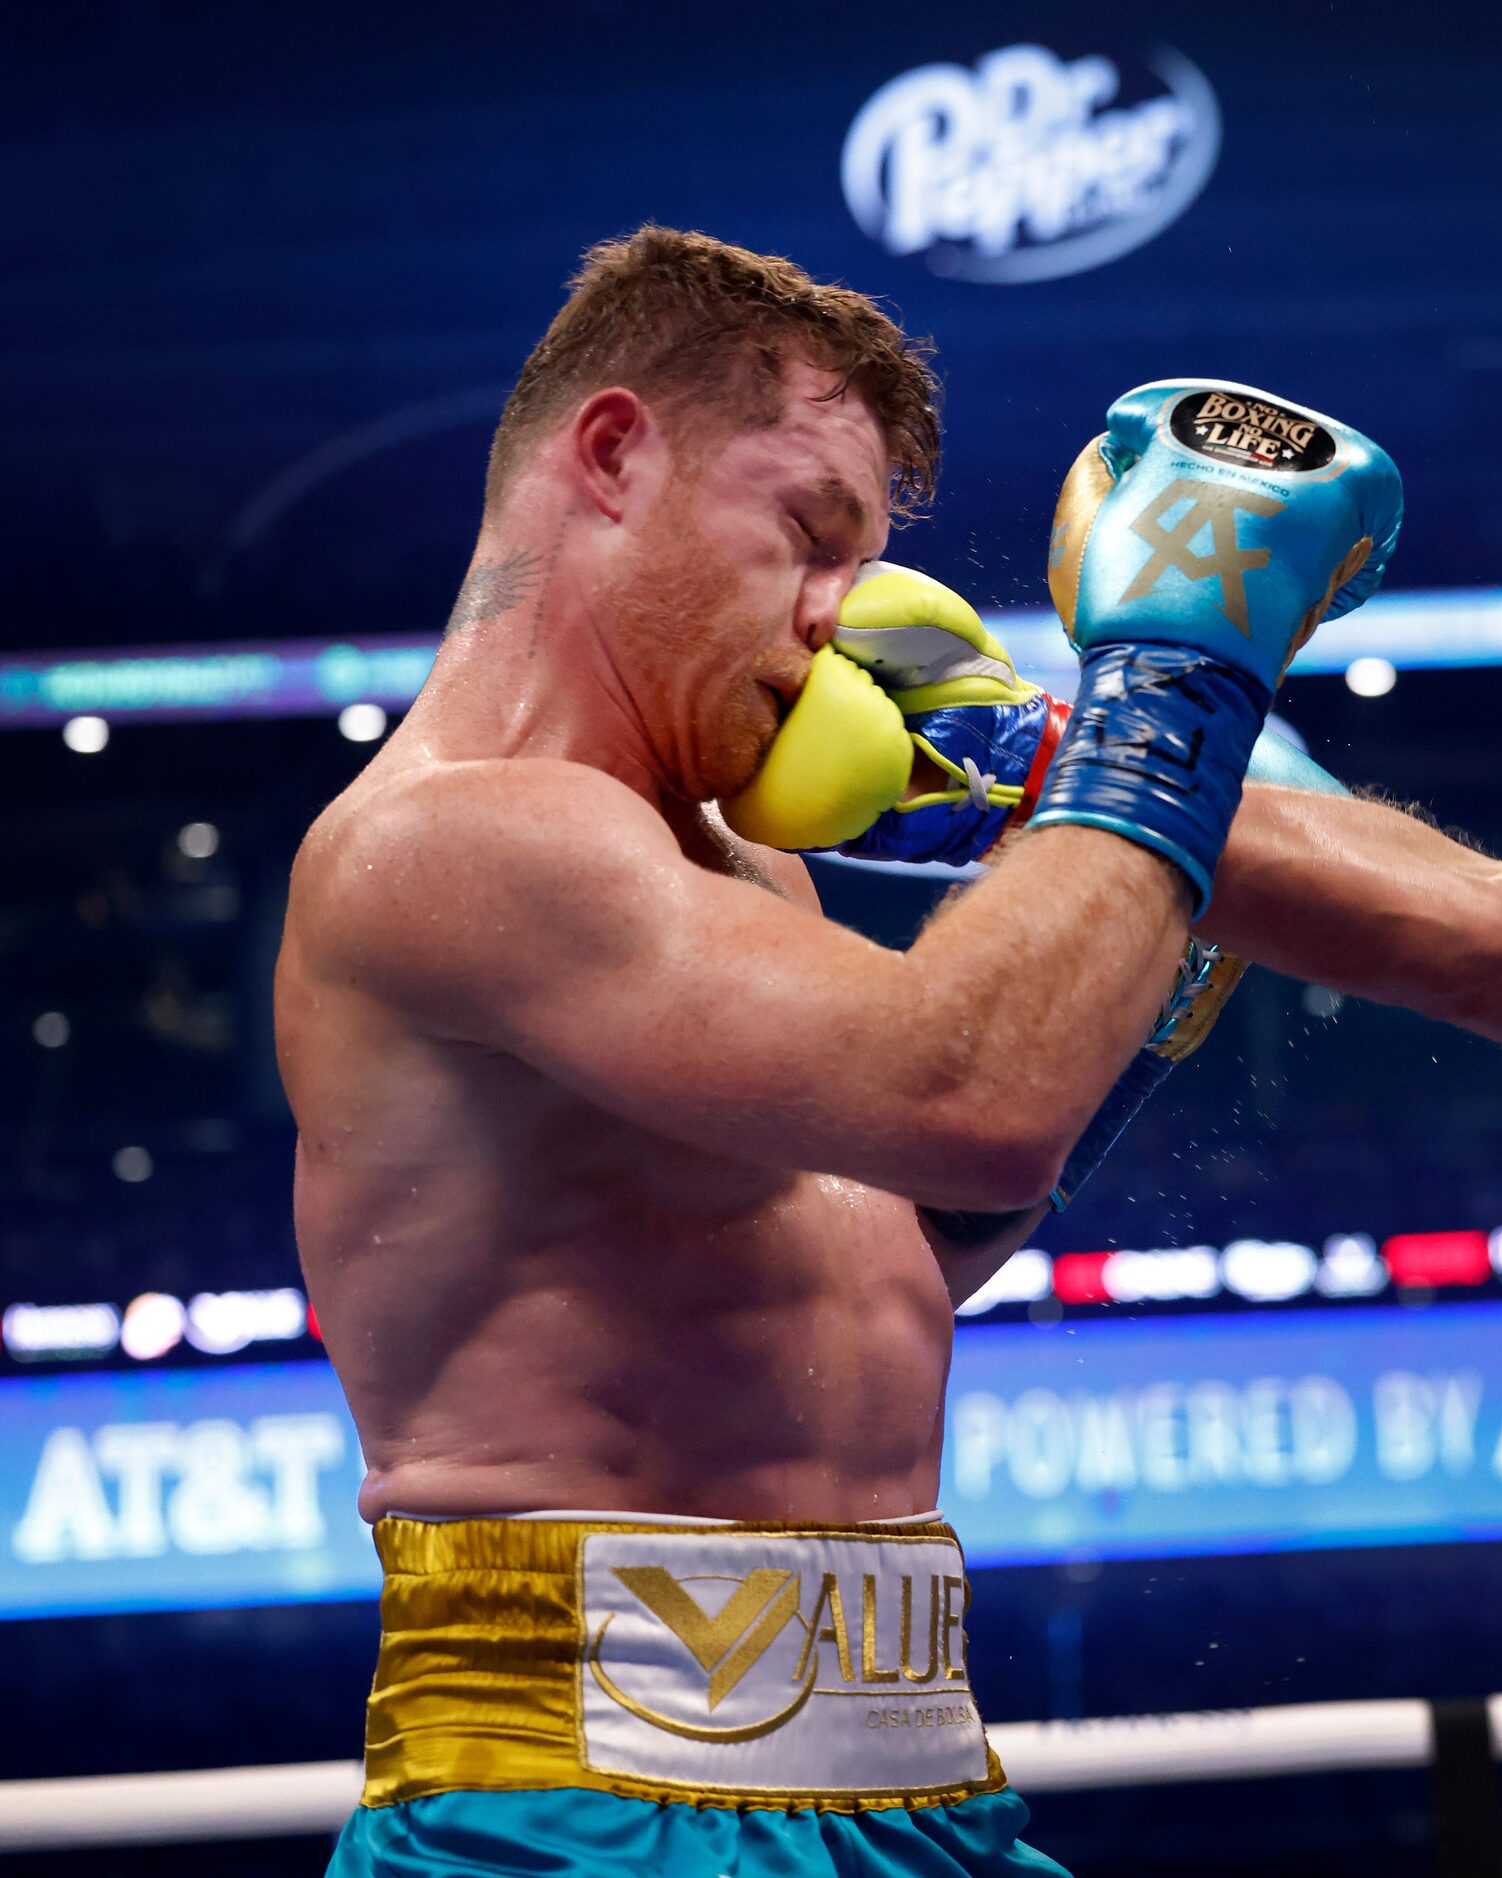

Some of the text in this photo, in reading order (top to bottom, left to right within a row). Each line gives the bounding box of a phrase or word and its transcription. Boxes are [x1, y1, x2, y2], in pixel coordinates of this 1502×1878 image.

[1195, 392, 1318, 449] BOXING
[1251, 402, 1280, 417] NO
[1205, 422, 1282, 461] LIFE
[1237, 422, 1264, 437] NO
[1170, 460, 1291, 498] HECHO EN MEXICO
[953, 1374, 1357, 1499] POWERED
[1372, 1367, 1485, 1481] BY
[13, 1412, 344, 1563] AT&T
[866, 1704, 977, 1730] CASA DE BOLSA
